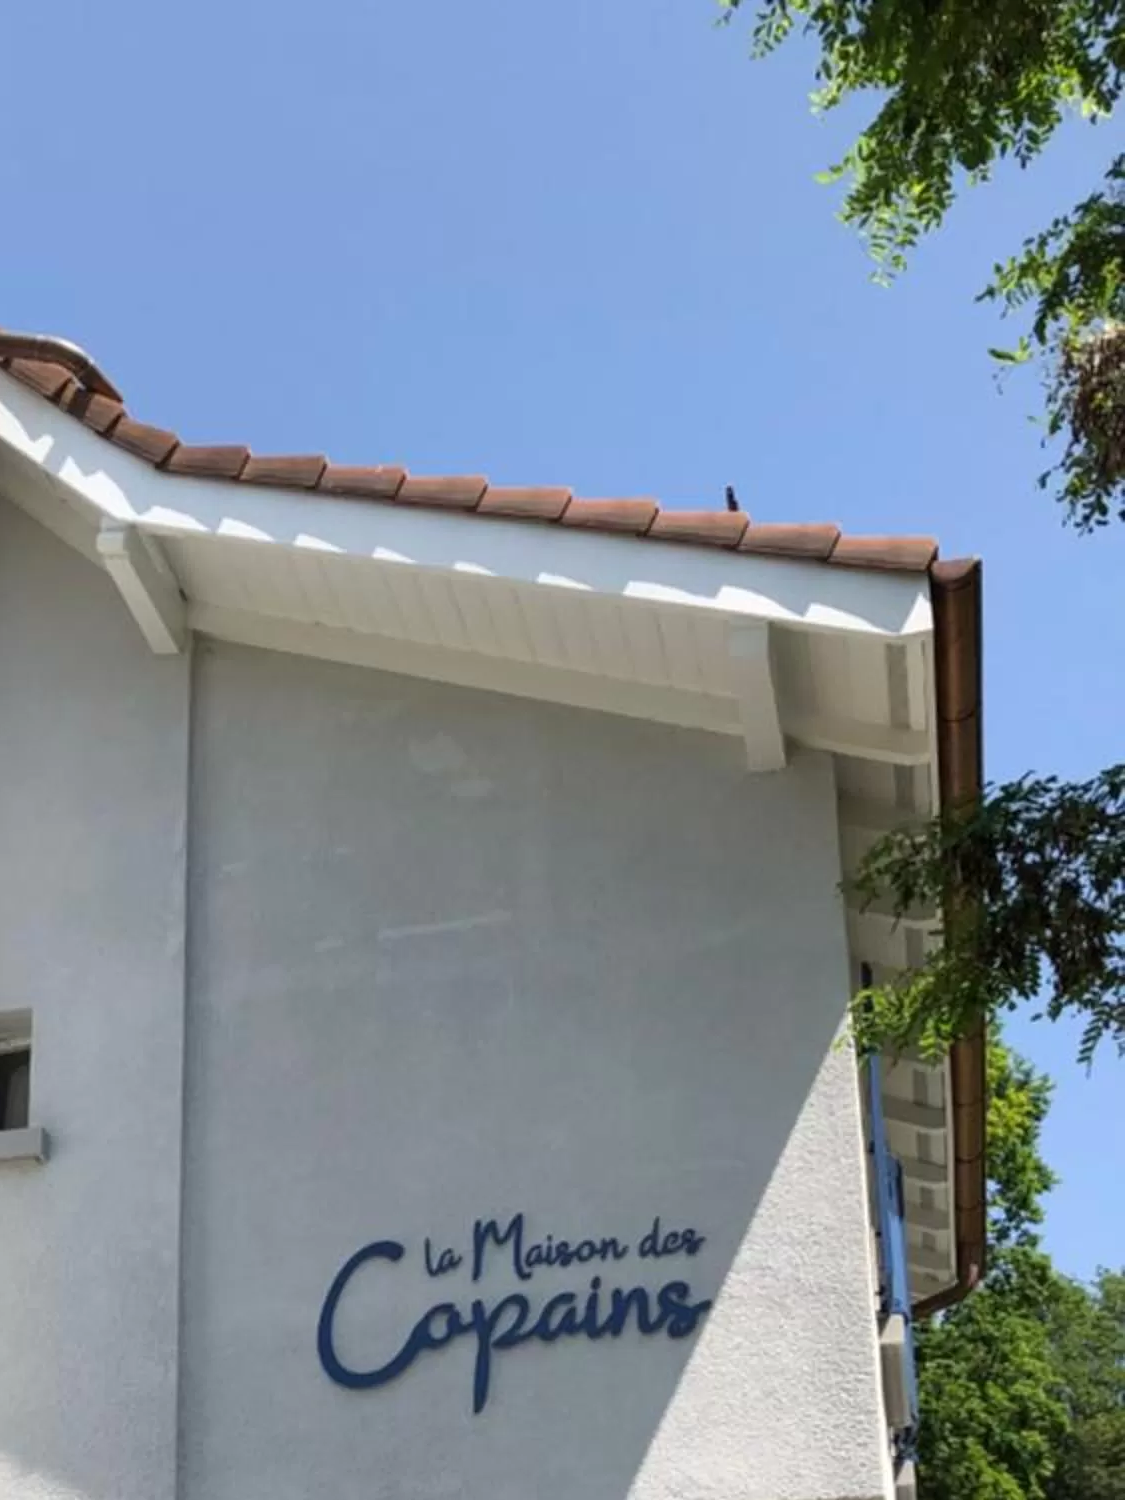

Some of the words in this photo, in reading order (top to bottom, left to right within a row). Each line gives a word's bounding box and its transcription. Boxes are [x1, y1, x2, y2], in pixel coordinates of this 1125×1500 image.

[425, 1237, 463, 1278] la
[472, 1213, 629, 1281] Maison
[639, 1216, 706, 1261] des
[317, 1240, 713, 1414] Copains
